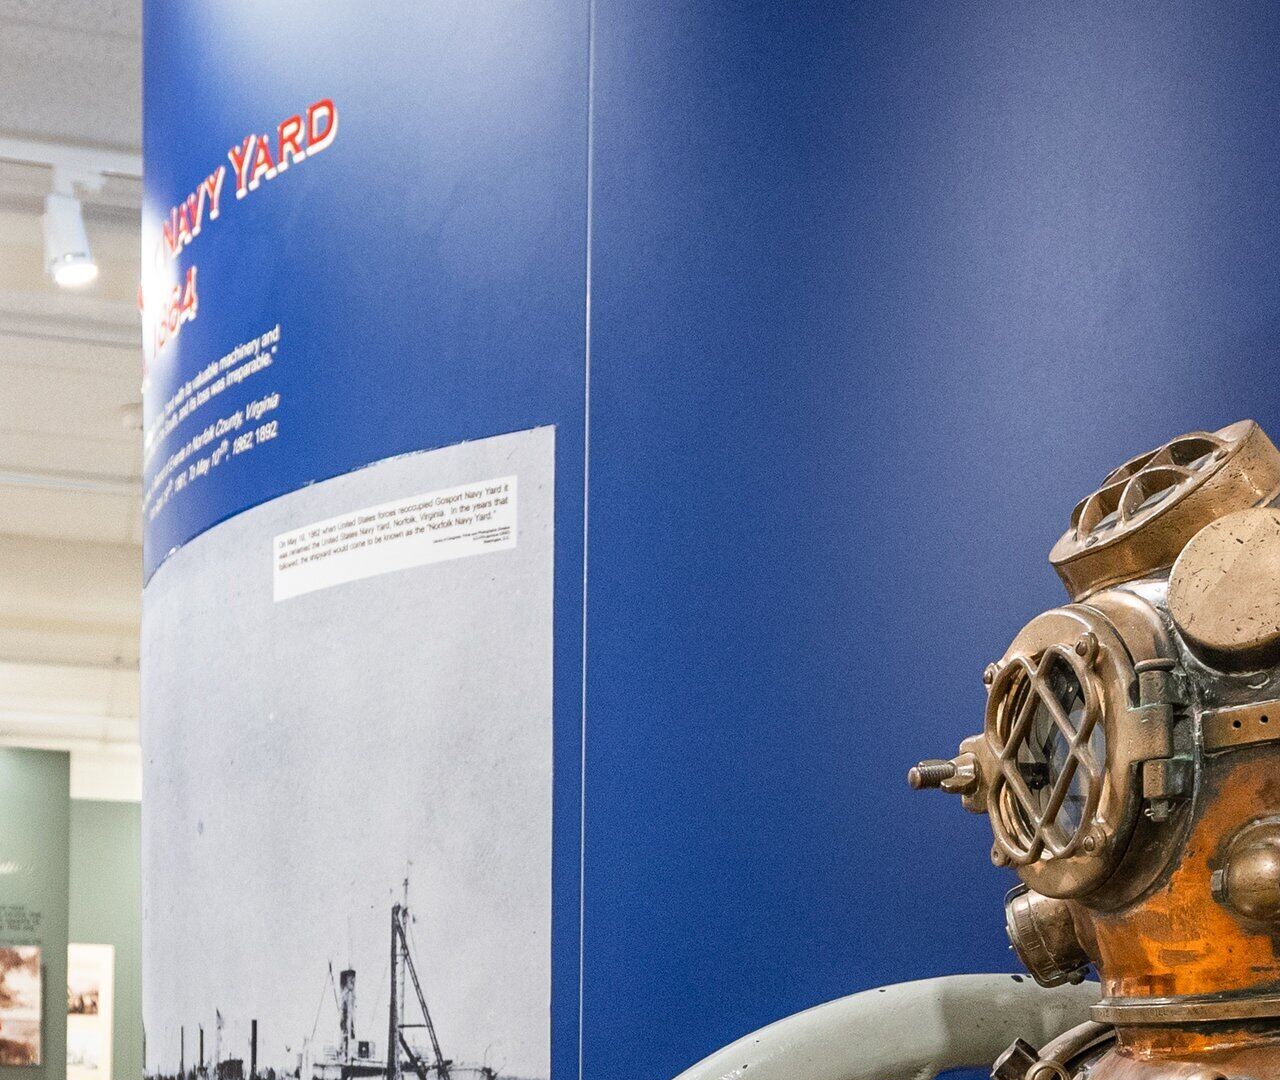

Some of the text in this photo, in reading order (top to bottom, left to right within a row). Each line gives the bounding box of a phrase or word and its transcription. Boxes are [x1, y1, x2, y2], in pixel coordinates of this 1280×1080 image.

[162, 97, 338, 260] NAVY YARD
[220, 337, 261, 371] machinery
[261, 324, 280, 349] and
[211, 377, 226, 396] was
[246, 392, 280, 421] Virginia
[435, 494, 462, 506] Gosport
[465, 490, 482, 500] Navy
[485, 485, 502, 495] Yard
[459, 504, 471, 513] the
[473, 501, 492, 512] years
[494, 497, 508, 505] that
[384, 530, 405, 540] known
[415, 526, 425, 534] the
[455, 516, 473, 526] Navy
